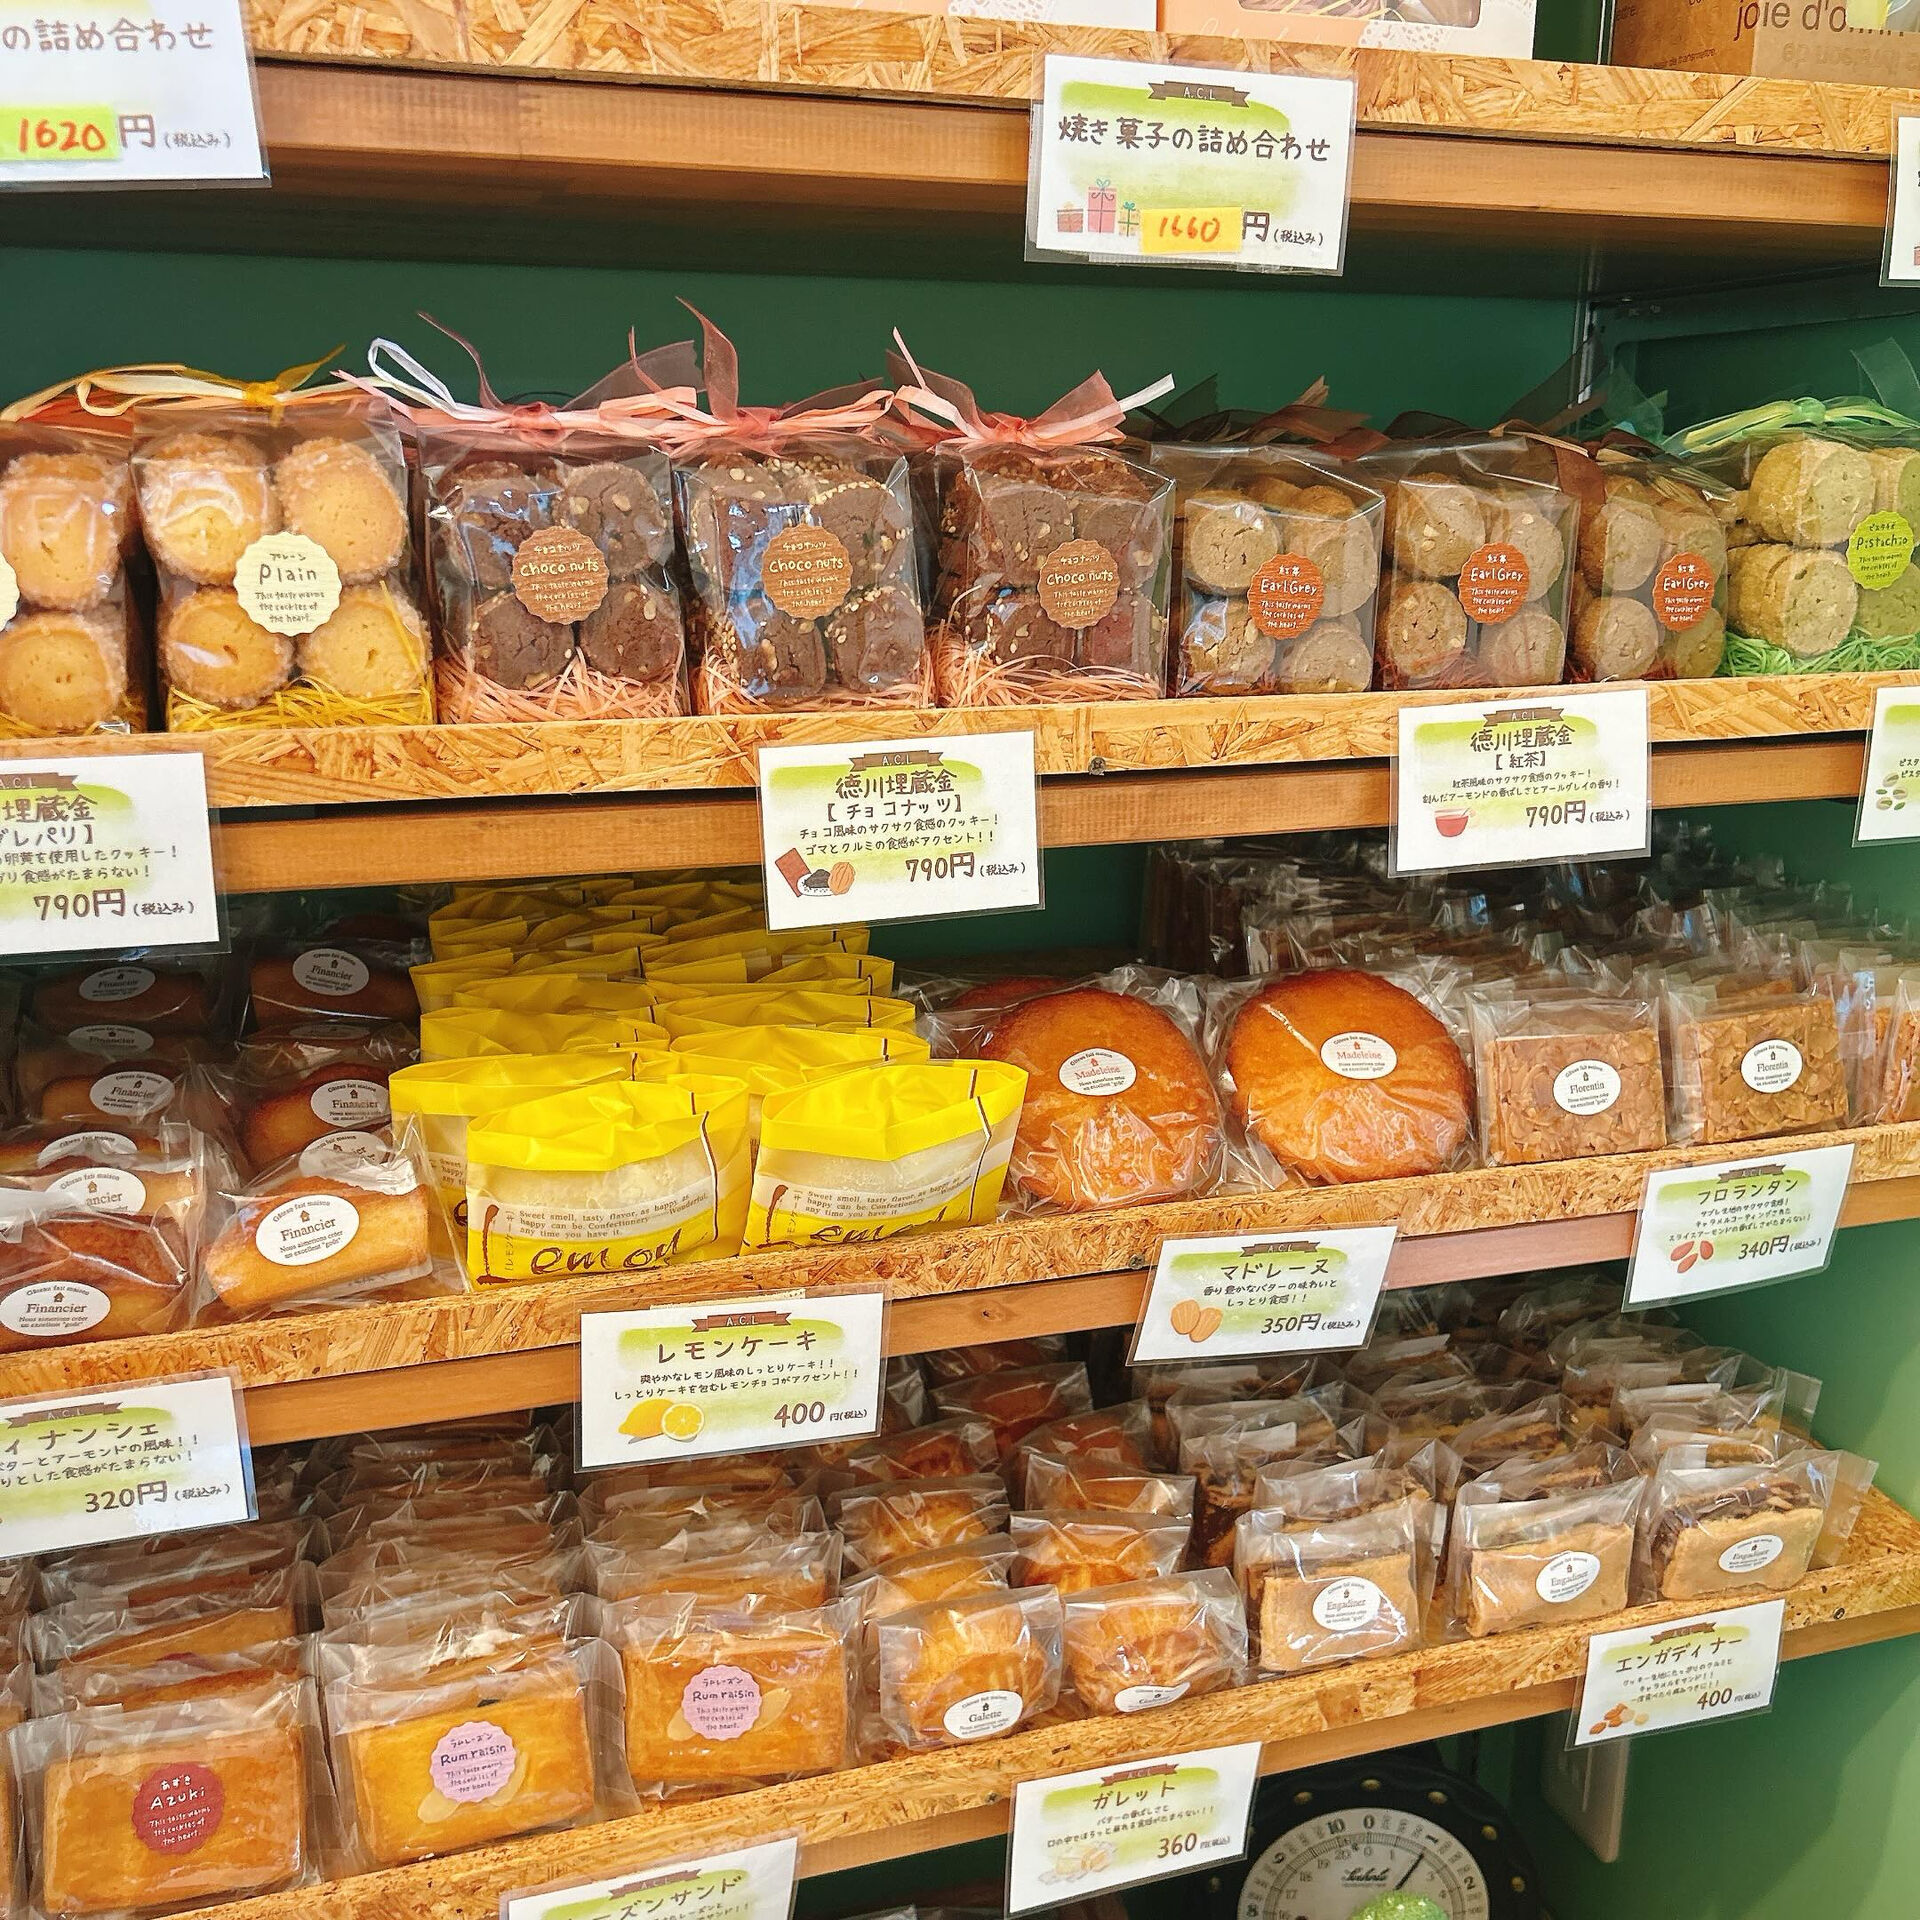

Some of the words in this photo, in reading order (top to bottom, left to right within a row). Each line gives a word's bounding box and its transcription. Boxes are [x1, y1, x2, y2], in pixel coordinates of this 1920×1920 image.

[2, 17, 213, 51] の詰め合わせ
[20, 117, 107, 153] 1620
[118, 113, 156, 148] 円
[1058, 112, 1331, 162] 焼き菓子の詰め合わせ
[1159, 215, 1220, 243] 1660
[1242, 210, 1270, 242] 円
[1856, 534, 1908, 550] Pistachio
[260, 563, 317, 585] Plain
[569, 558, 600, 572] nuts
[816, 556, 844, 570] nuts
[1089, 569, 1113, 581] nuts
[1470, 723, 1576, 752] 徳川埋蔵金
[834, 768, 958, 800] 徳川埋蔵金
[2, 794, 98, 823] 埋蔵金
[1525, 800, 1586, 828] 790円
[905, 851, 975, 883] 790円
[34, 888, 126, 921] 790円
[1697, 1178, 1798, 1206] フロランタン
[519, 1210, 546, 1220] Sweet
[281, 1218, 336, 1241] Financier
[1738, 1235, 1790, 1260] 340円
[1220, 1258, 1330, 1281] マドレーヌ
[26, 1302, 88, 1313] Financier
[1260, 1312, 1323, 1334] 350円
[657, 1330, 818, 1365] レモンケーキ
[773, 1401, 825, 1429] 400
[84, 1480, 168, 1513] 320円
[1616, 1636, 1743, 1673] エンガディナー
[692, 1690, 718, 1702] Rum
[721, 1690, 754, 1699] raisin
[1697, 1688, 1732, 1710] 400
[969, 1710, 1002, 1722] Galette
[440, 1753, 468, 1766] Rum
[471, 1744, 507, 1759] raisin
[150, 1786, 205, 1810] Azuki
[1093, 1780, 1175, 1810] ガレット
[1157, 1832, 1197, 1859] 360
